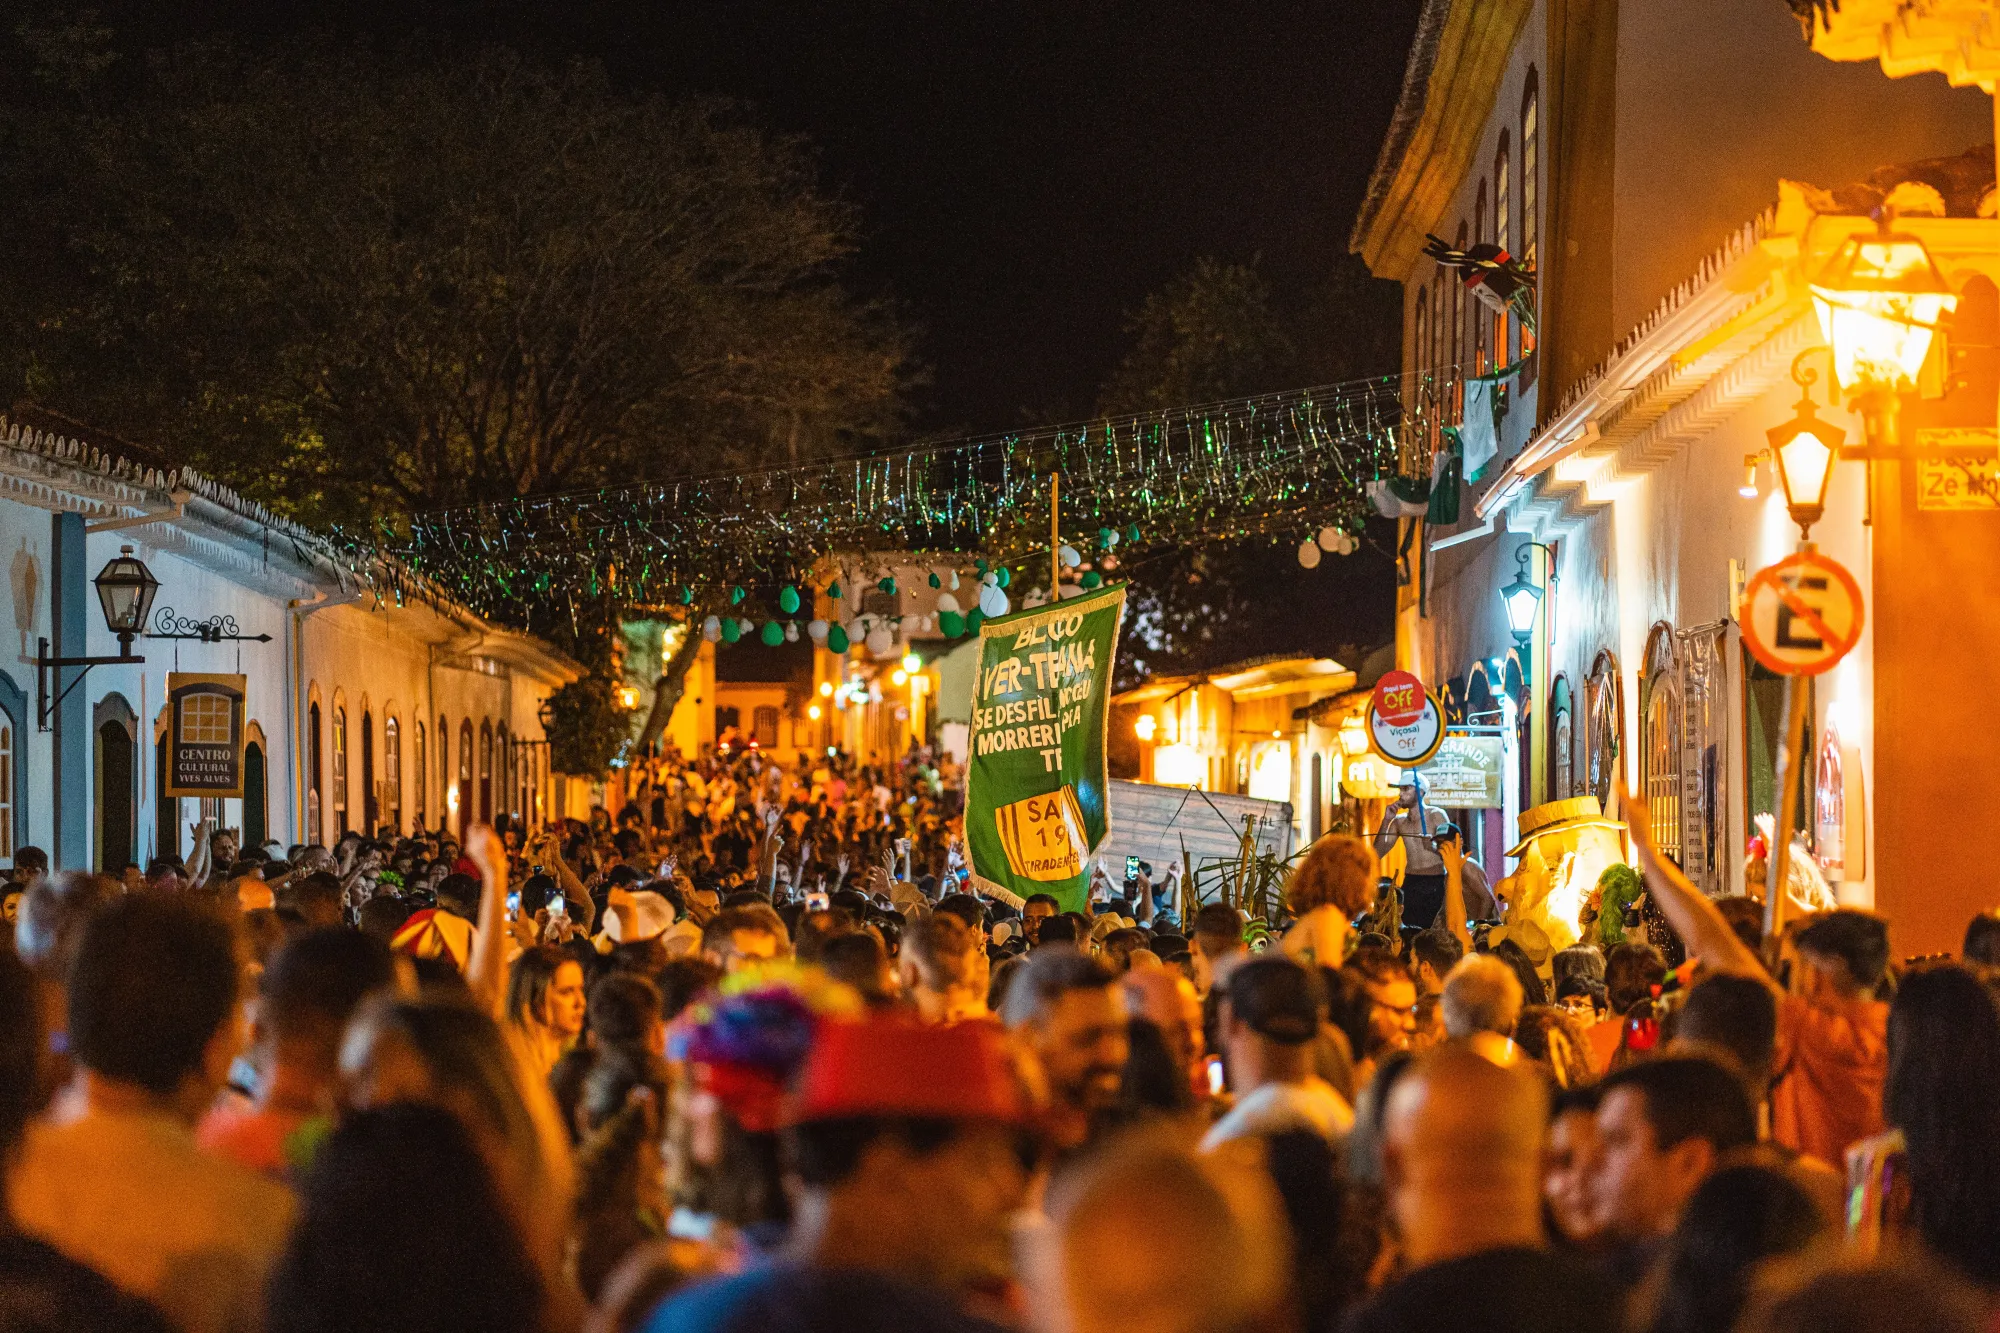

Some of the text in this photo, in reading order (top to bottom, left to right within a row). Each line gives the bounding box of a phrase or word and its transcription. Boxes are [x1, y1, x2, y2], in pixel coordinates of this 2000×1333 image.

[1776, 576, 1828, 649] E
[976, 707, 993, 730] SE
[995, 697, 1058, 726] DESFIL
[978, 722, 1061, 756] MORRERI
[180, 749, 231, 761] CENTRO
[1438, 740, 1490, 768] GRANDE
[179, 762, 230, 772] CULTURAL
[179, 774, 230, 783] YVES ALVES
[1027, 799, 1060, 822] SA
[1036, 824, 1066, 847] 19
